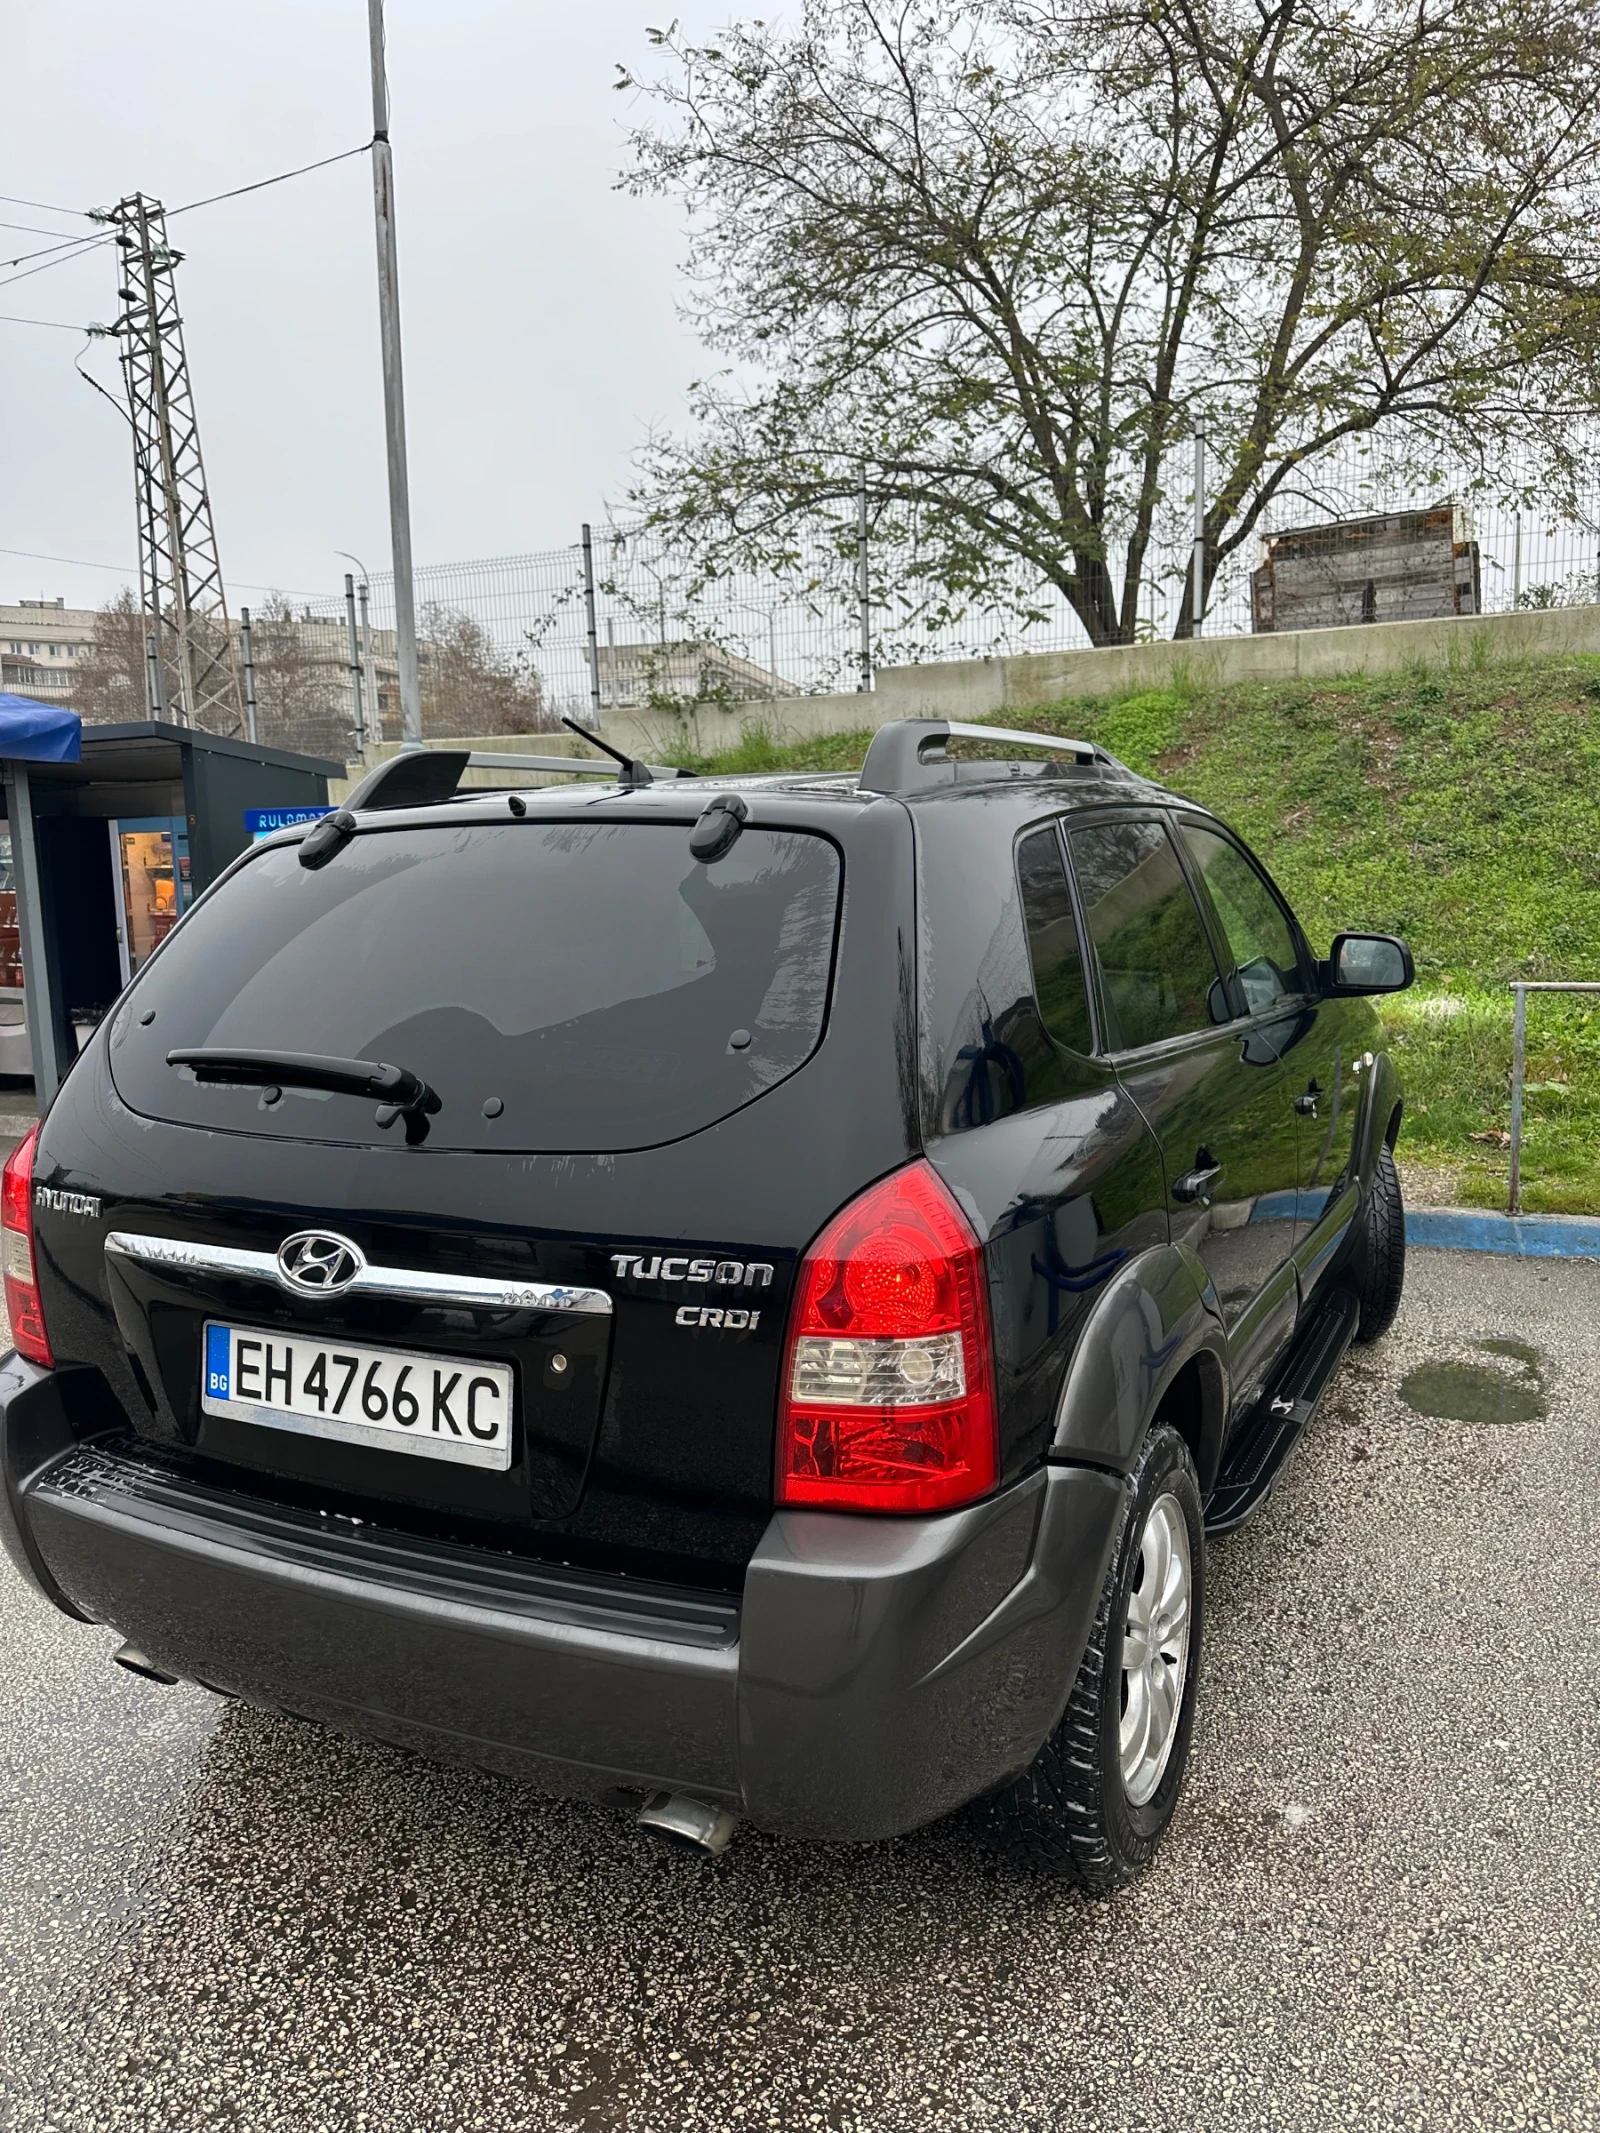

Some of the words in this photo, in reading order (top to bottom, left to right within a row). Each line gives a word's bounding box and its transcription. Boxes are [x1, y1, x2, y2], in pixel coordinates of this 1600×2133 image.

[35, 1186, 102, 1218] HYUNDAI
[610, 1254, 774, 1287] TUCSON
[210, 1372, 228, 1391] BG
[236, 1339, 293, 1406] EH
[303, 1352, 420, 1426] 4766
[432, 1369, 500, 1440] KC
